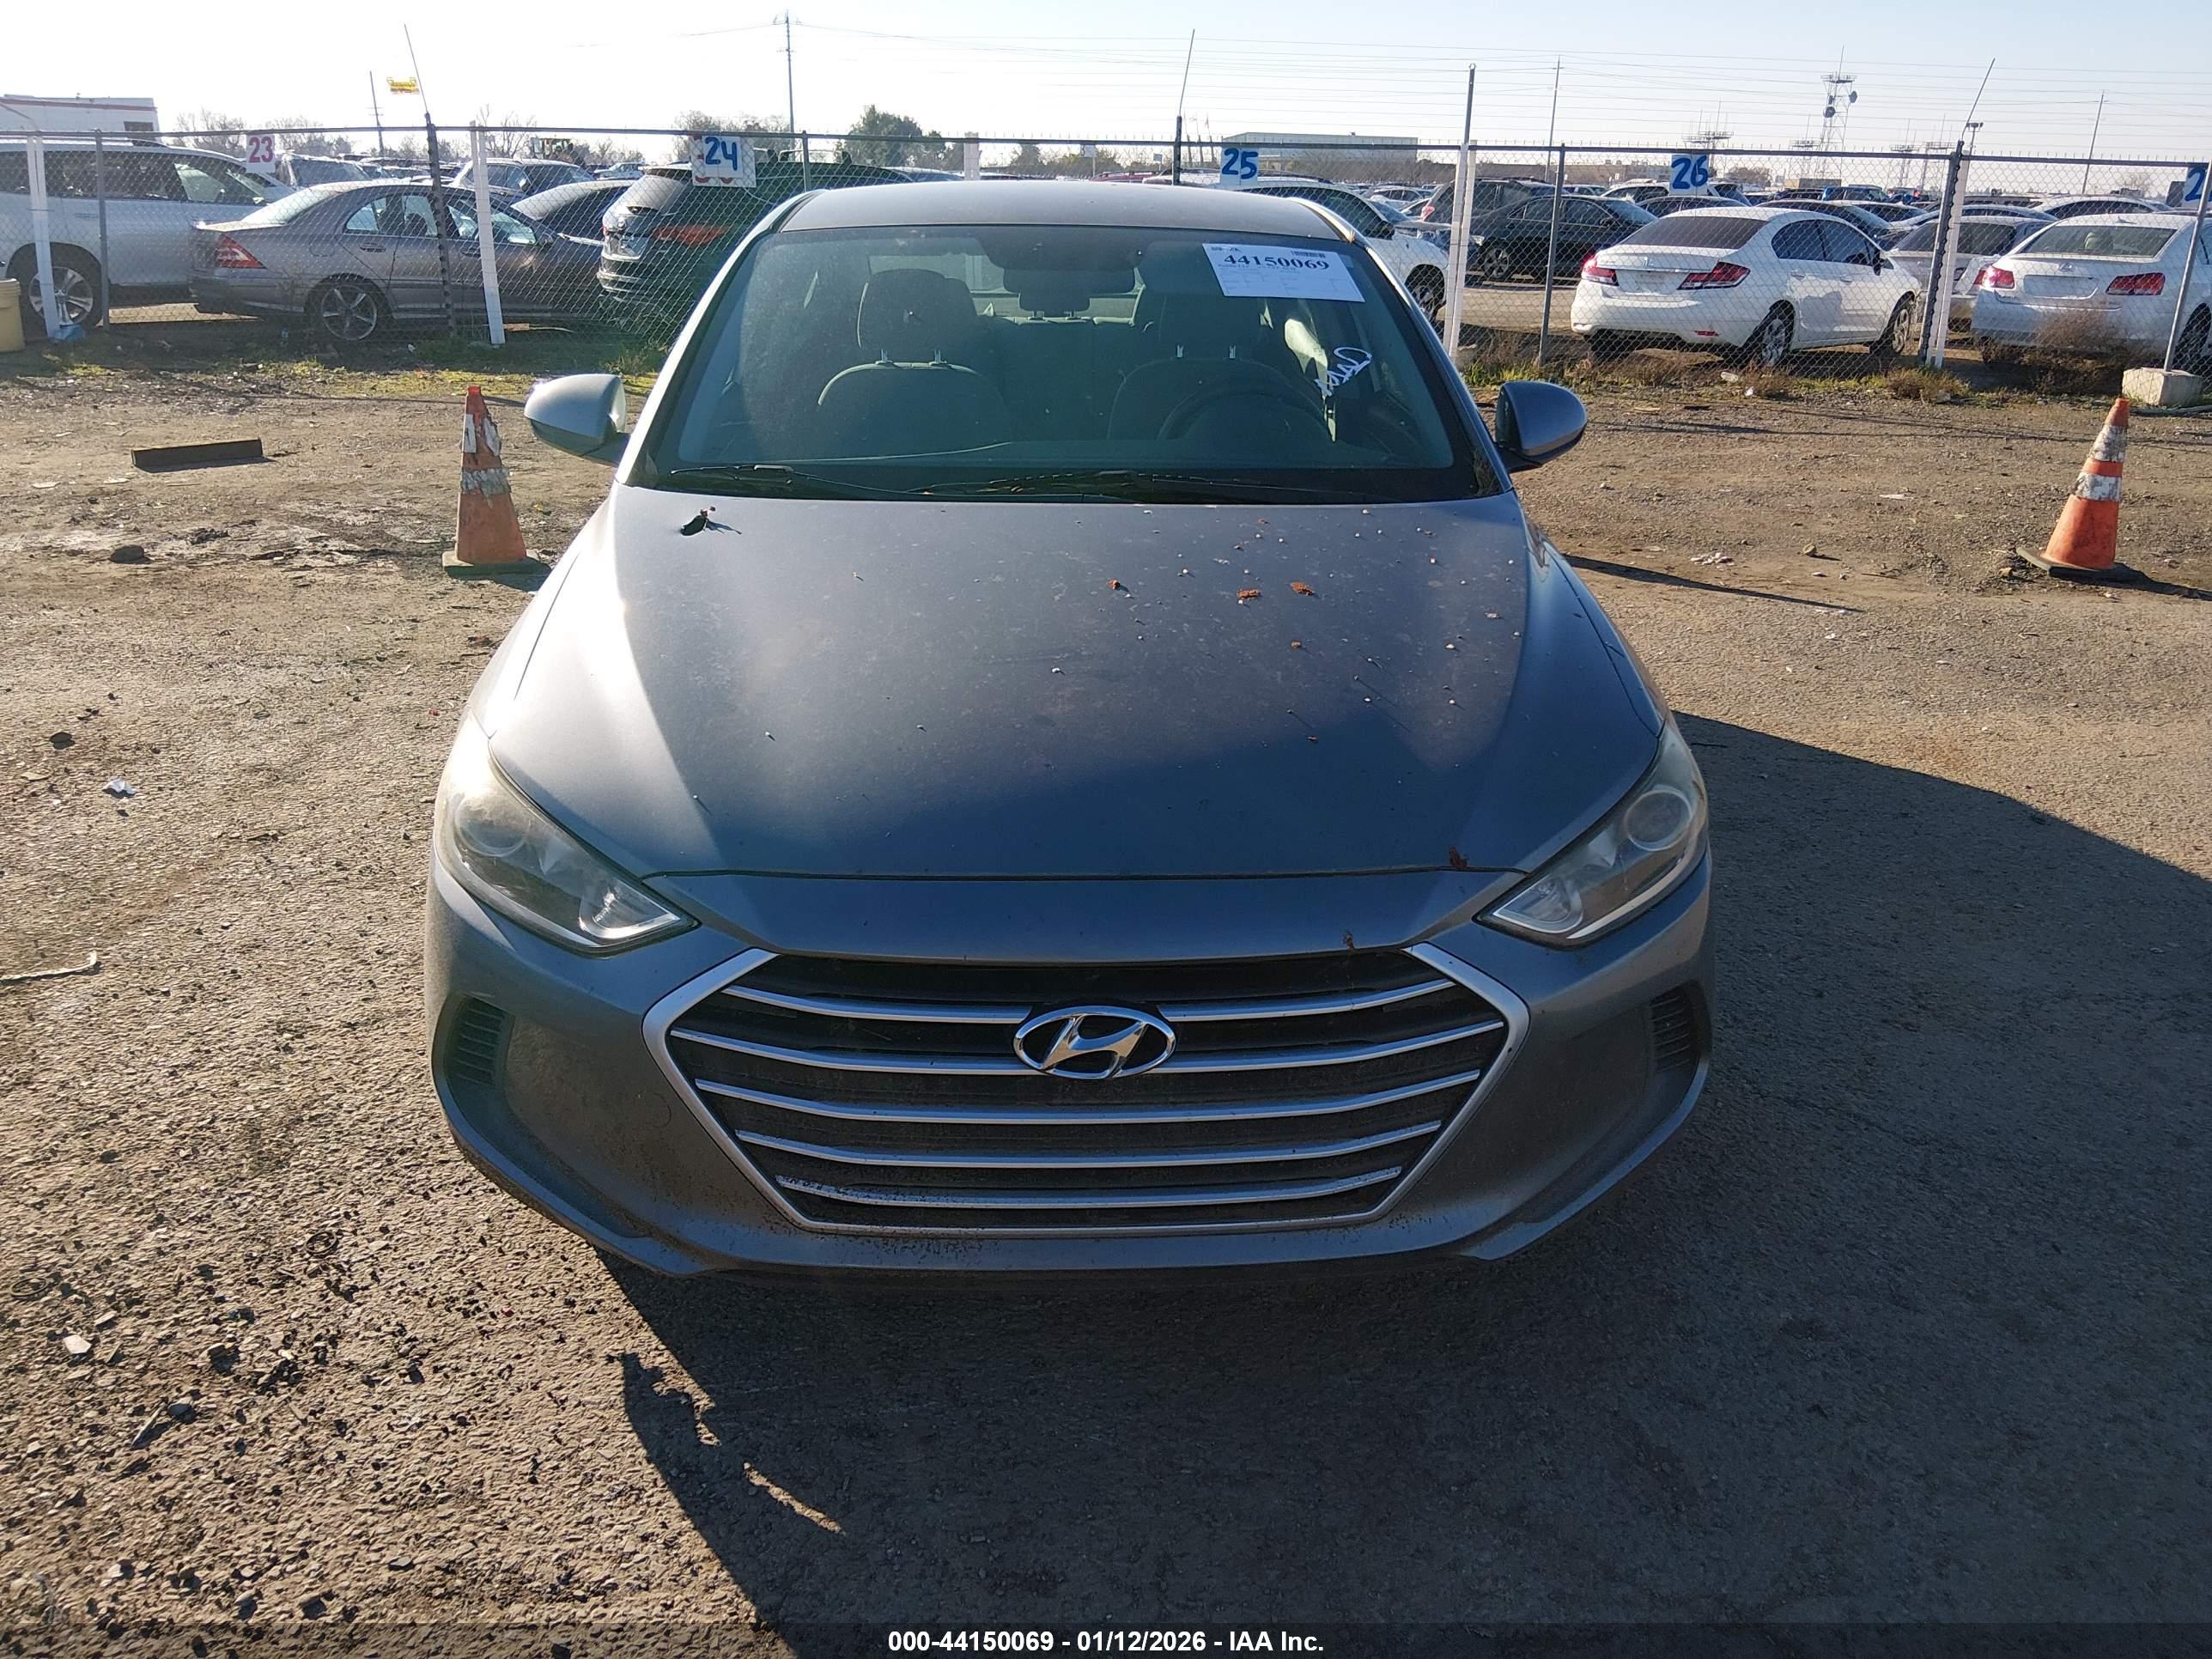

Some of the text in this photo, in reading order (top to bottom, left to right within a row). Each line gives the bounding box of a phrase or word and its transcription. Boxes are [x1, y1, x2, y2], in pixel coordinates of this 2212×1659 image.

[248, 136, 274, 163] 23
[704, 136, 738, 171] 24
[1221, 148, 1259, 180] 25
[1671, 155, 1709, 190] 26
[2184, 166, 2212, 203] 2
[1224, 254, 1330, 270] 44150069
